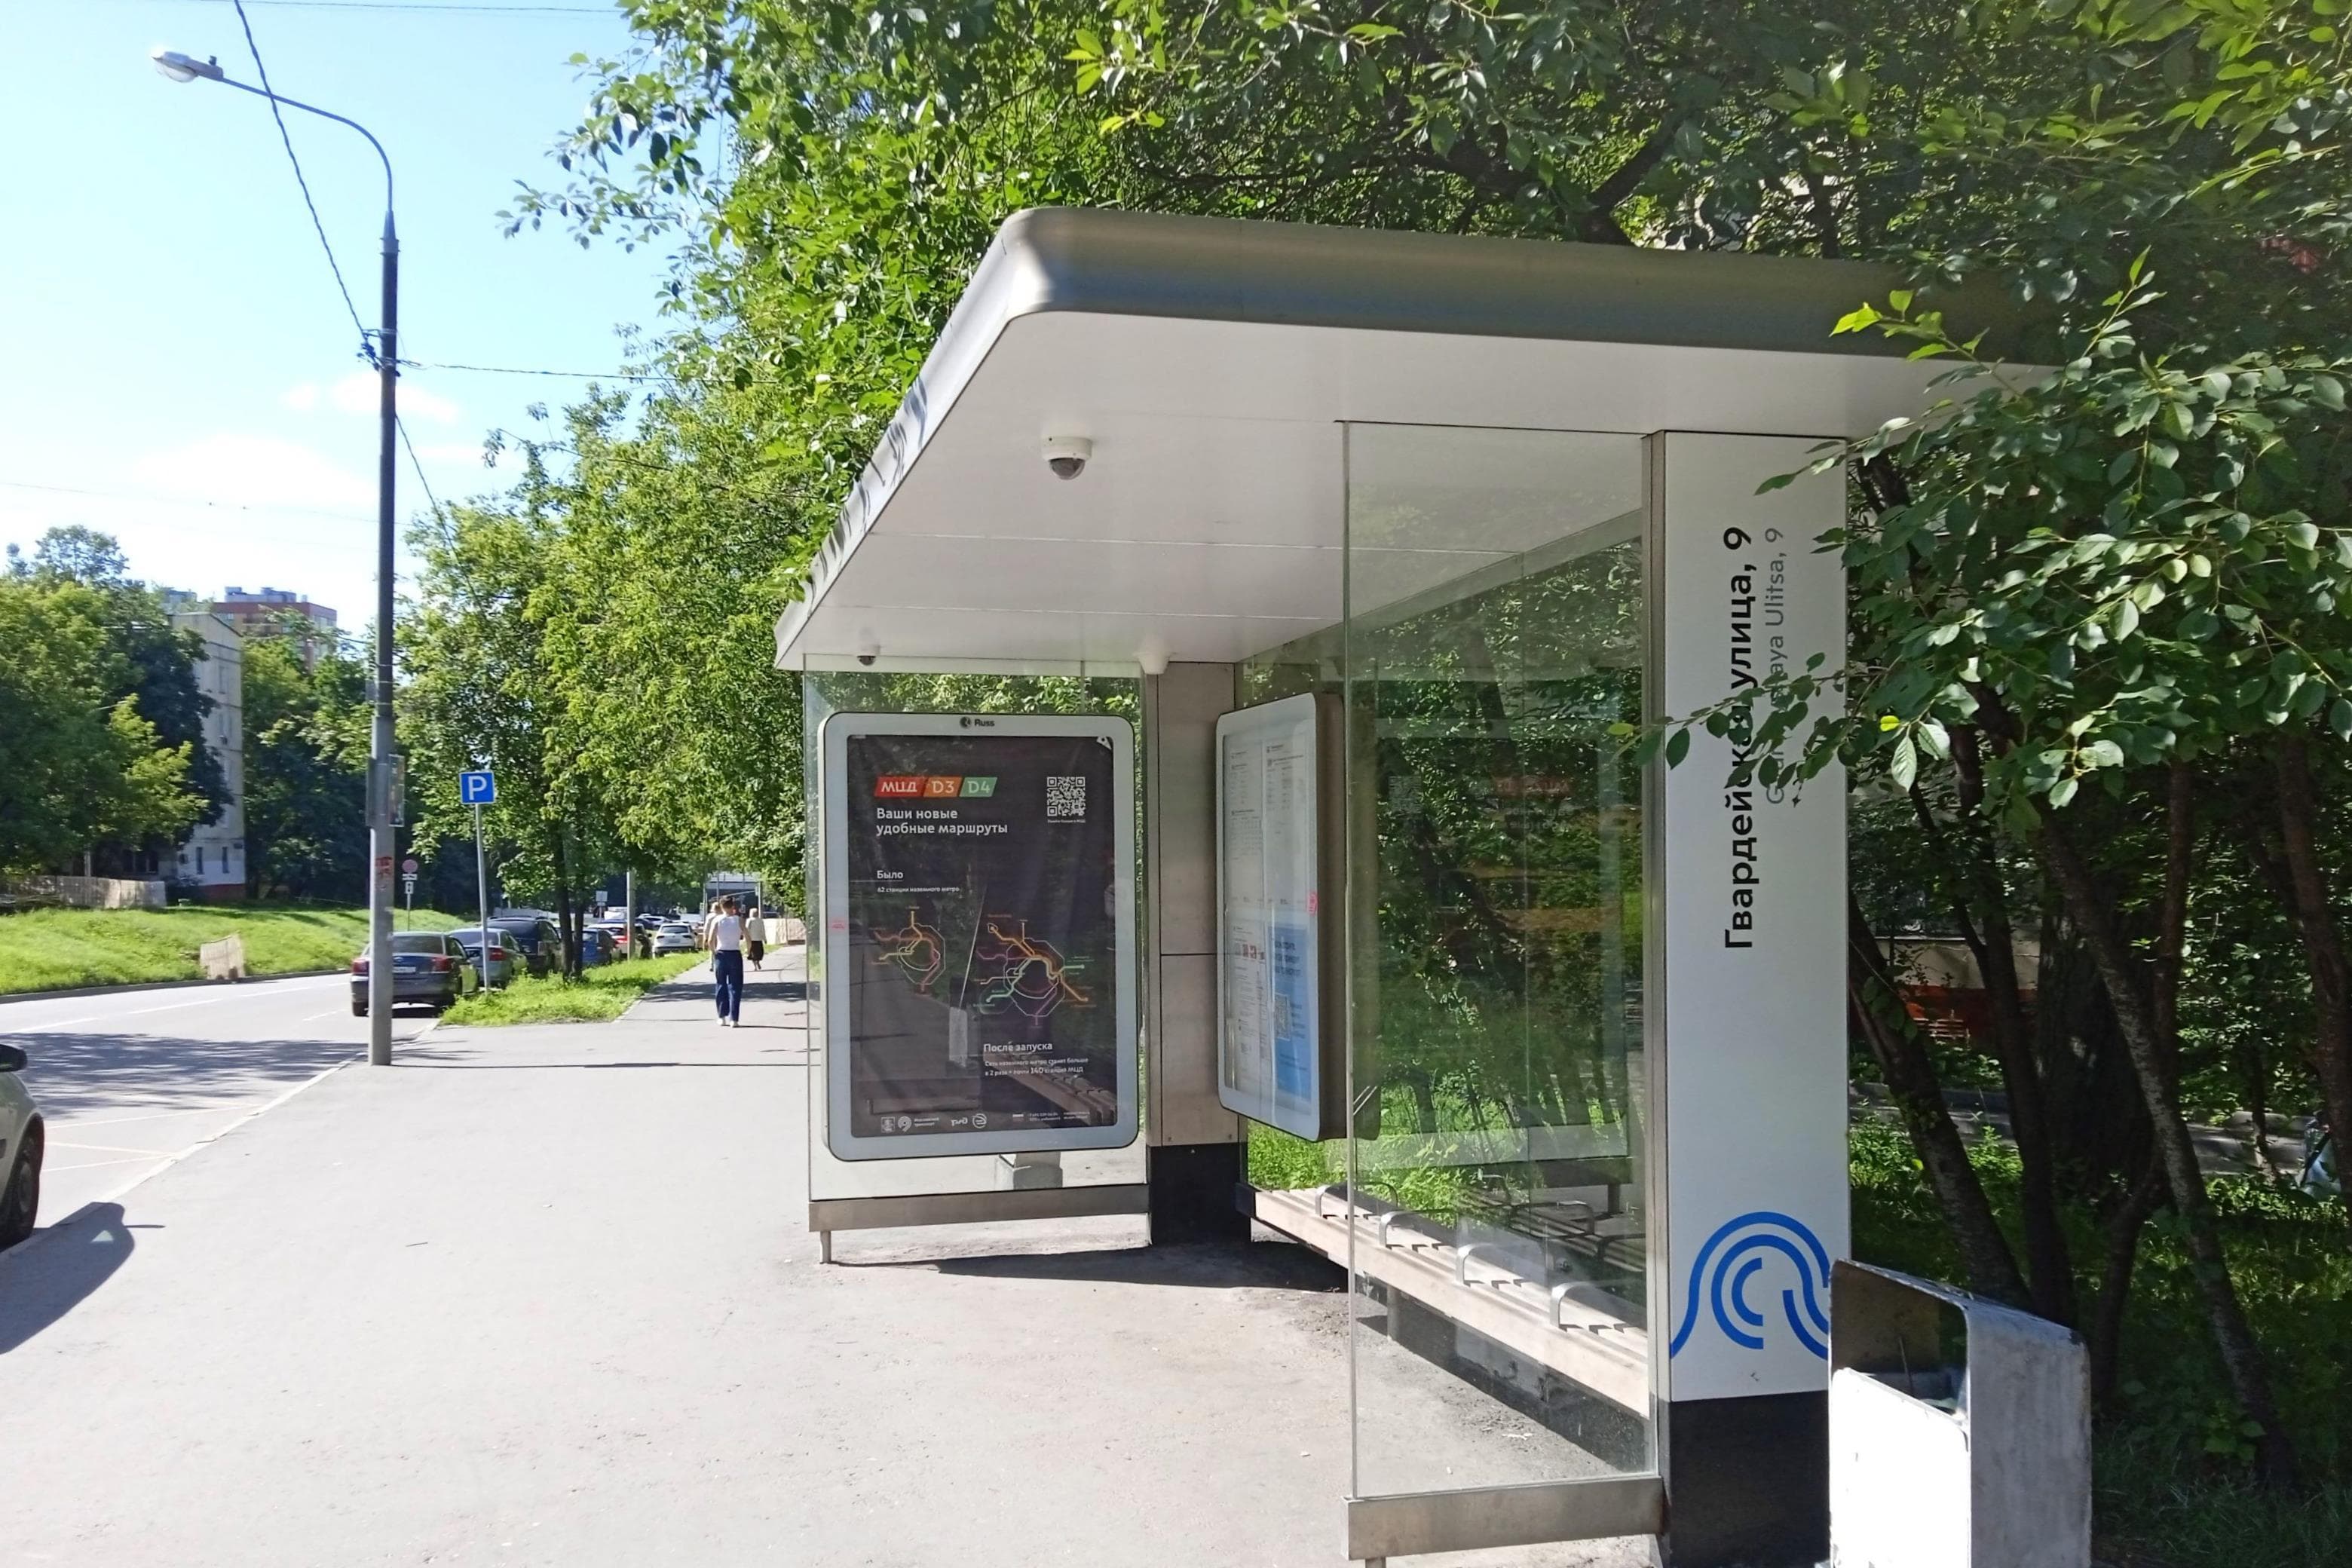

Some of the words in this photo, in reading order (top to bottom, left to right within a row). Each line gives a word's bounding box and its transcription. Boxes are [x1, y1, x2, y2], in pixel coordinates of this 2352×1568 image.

[1723, 527, 1752, 550] 9
[1765, 528, 1784, 543] 9
[1764, 553, 1787, 626] Ulitsa,
[1731, 564, 1758, 689] улица,
[974, 718, 995, 727] Russ
[467, 775, 487, 801] P
[880, 781, 917, 793] МЦД
[931, 781, 955, 794] D3
[967, 781, 991, 794] D4
[877, 807, 912, 819] Ваши
[916, 810, 958, 819] новые
[876, 822, 935, 837] удобные
[938, 825, 1008, 836] маршруты
[1724, 706, 1759, 948] Гвардейскя
[877, 870, 904, 879] Было
[984, 1043, 1014, 1052] После
[1015, 1043, 1053, 1053] запуска
